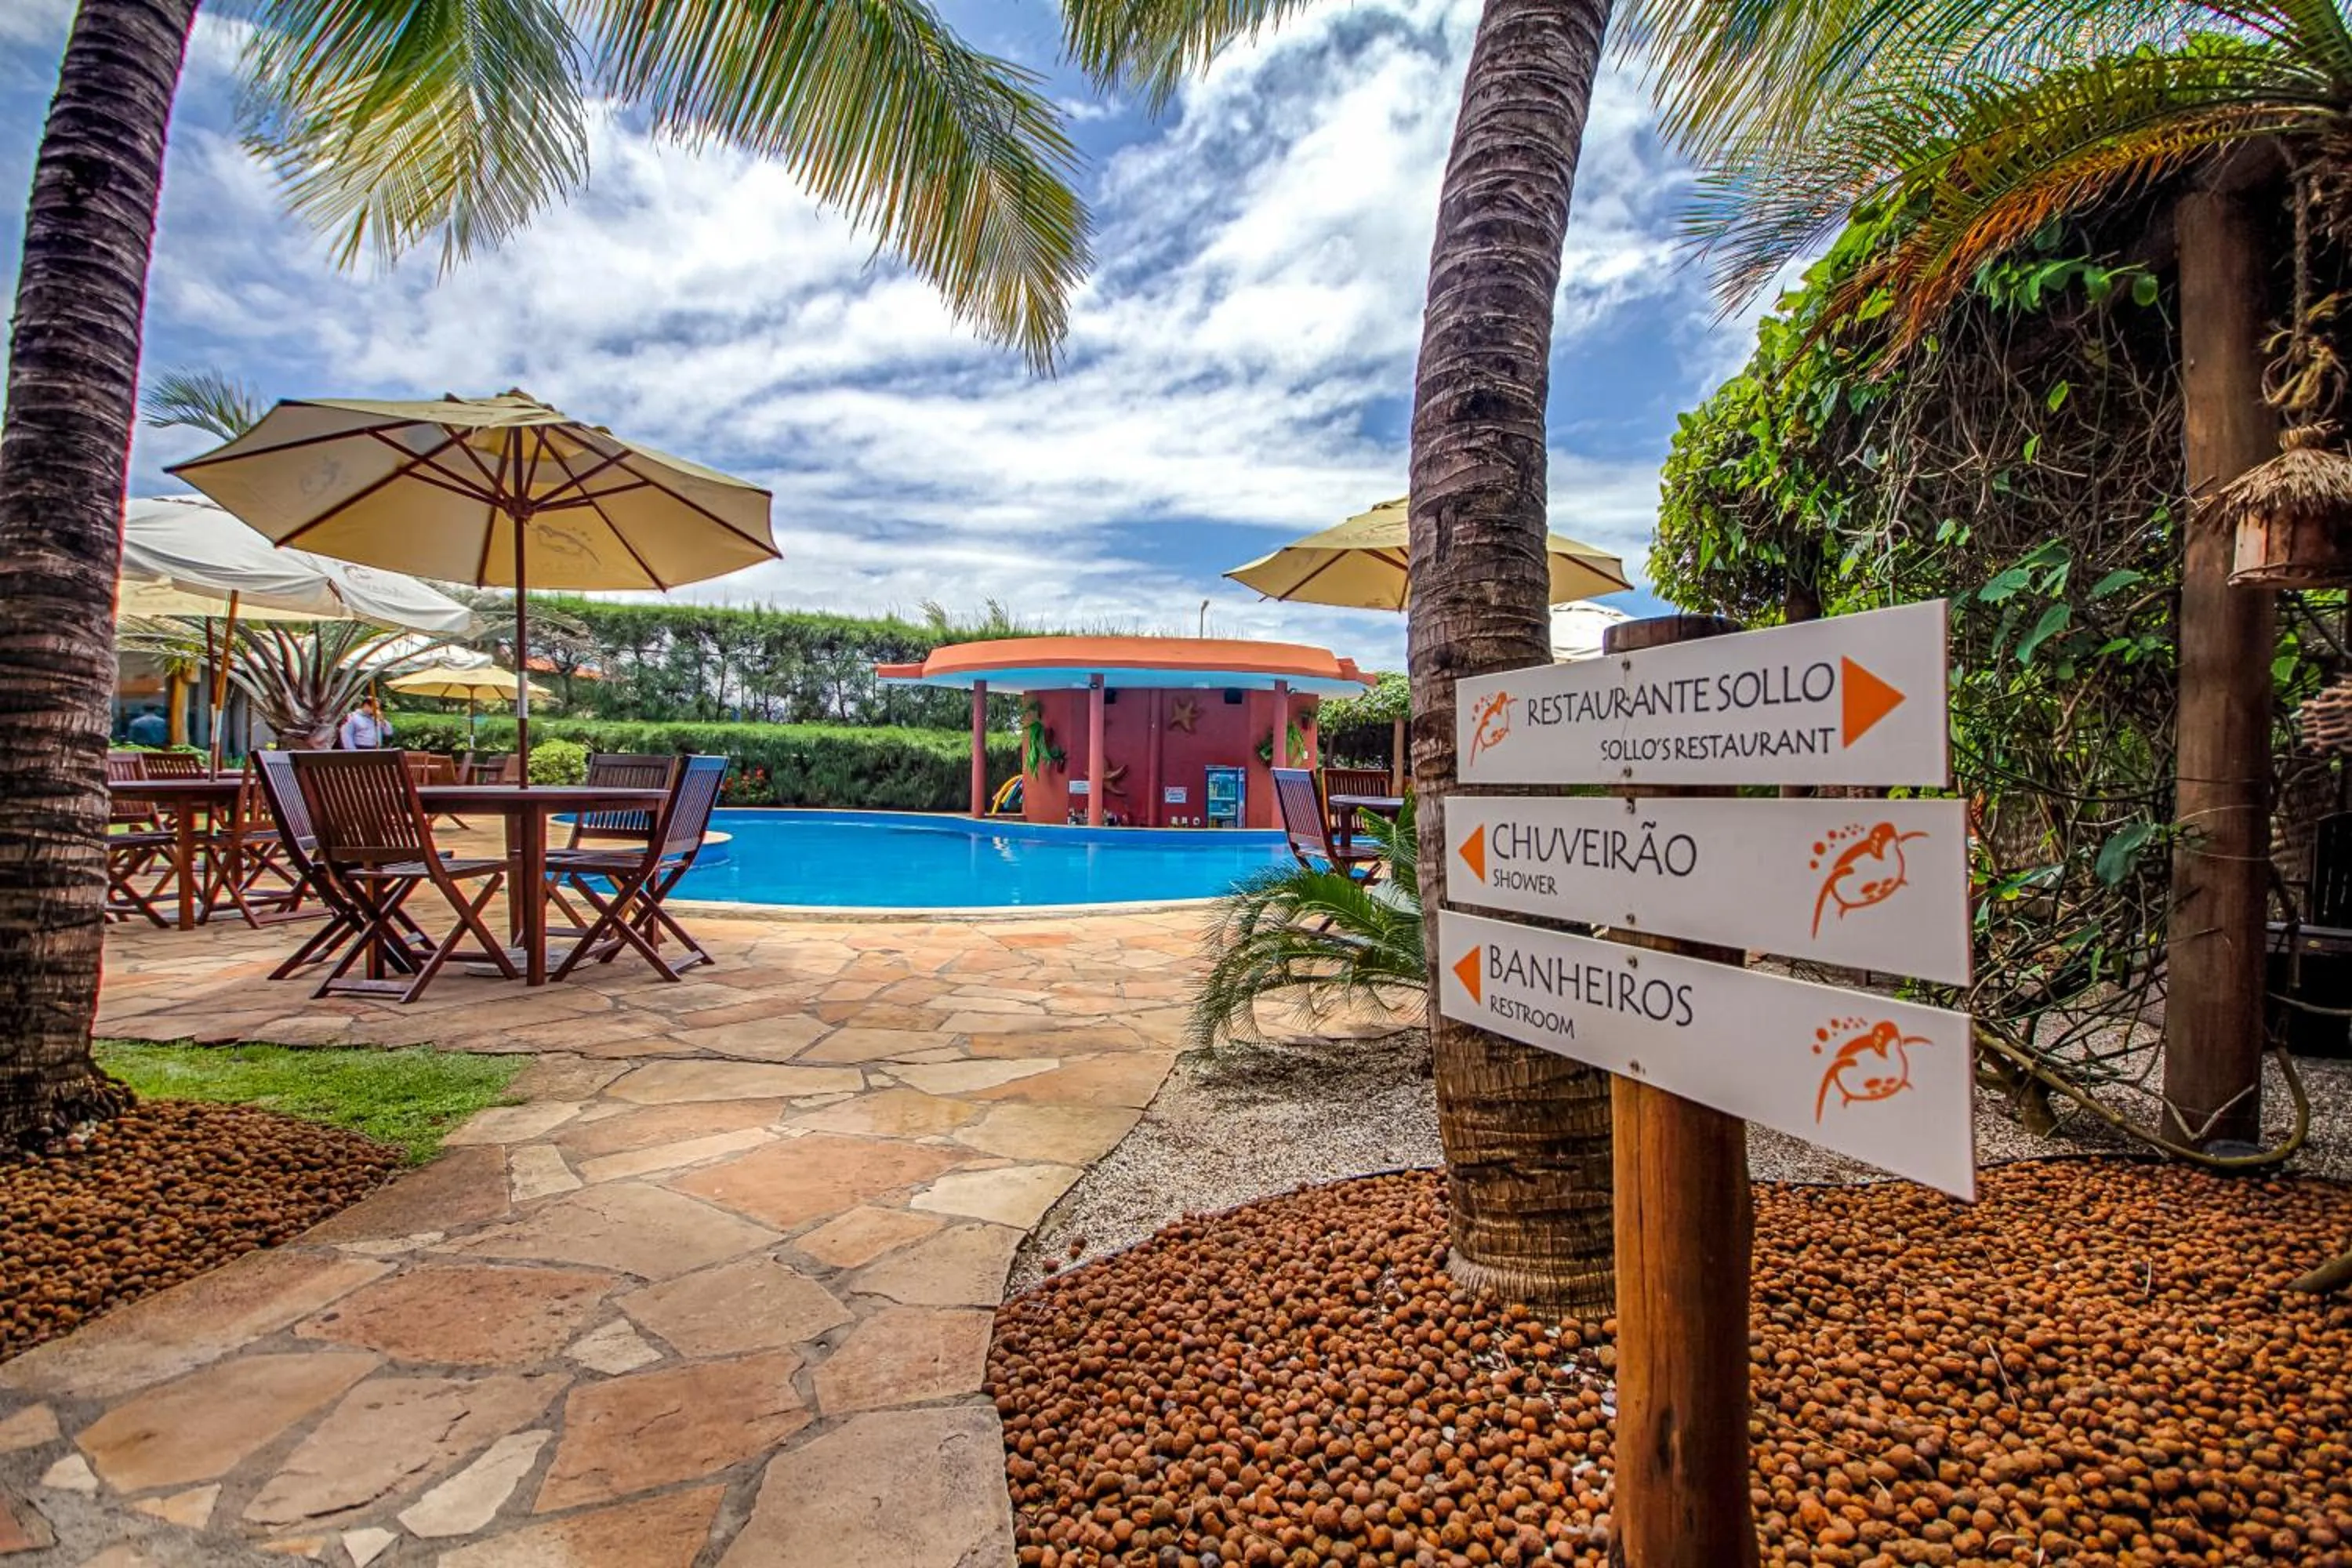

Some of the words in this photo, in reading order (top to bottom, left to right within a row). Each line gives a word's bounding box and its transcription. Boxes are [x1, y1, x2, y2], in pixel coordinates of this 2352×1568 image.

[1527, 677, 1711, 728] RESTAURANTE
[1716, 662, 1835, 713] SOLLO
[1600, 737, 1671, 762] SOLLO'S
[1675, 728, 1837, 760] RESTAURANT
[1492, 821, 1697, 877] CHUVEIRÃO
[1493, 868, 1558, 896] SHOWER
[1489, 944, 1693, 1027] BANHEIROS
[1490, 994, 1575, 1040] RESTROOM
